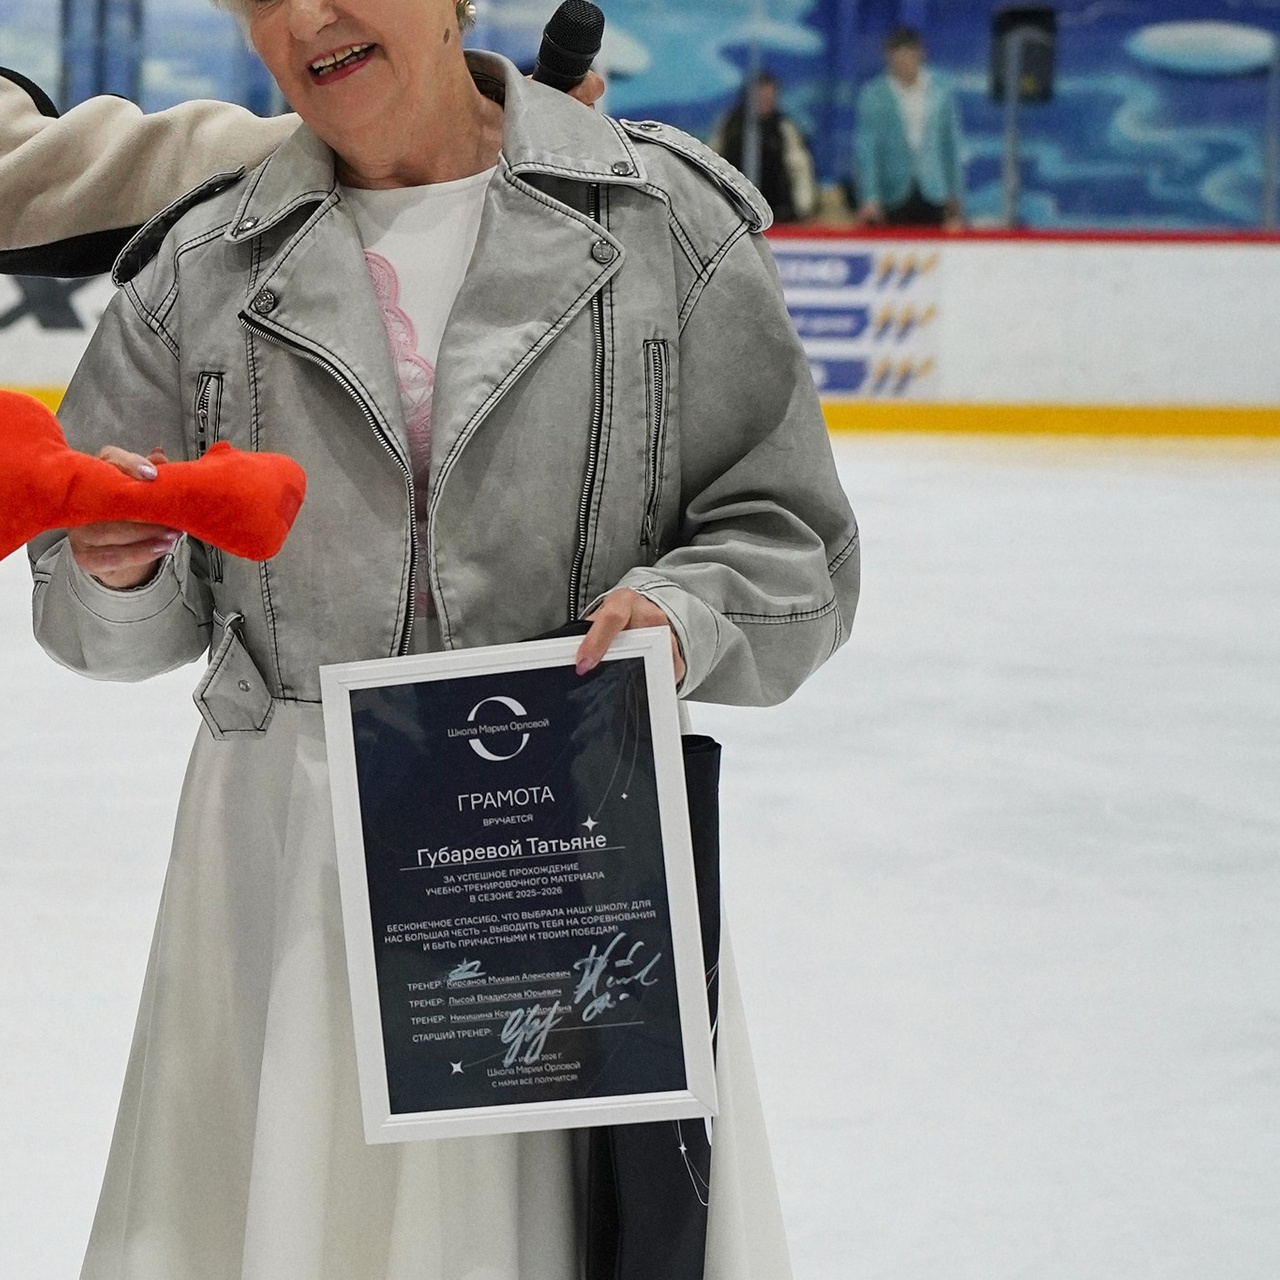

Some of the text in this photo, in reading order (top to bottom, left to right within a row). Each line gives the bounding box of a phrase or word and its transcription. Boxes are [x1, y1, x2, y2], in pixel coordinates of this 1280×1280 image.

[447, 718, 550, 738] Школа Марии Орловой
[457, 786, 555, 812] ГРАМОТА
[482, 813, 534, 827] ВРУЧАЕТСЯ
[417, 834, 607, 869] Губаревой Татьяне
[425, 871, 605, 896] УЧЕБНО-ТРЕНИРОВОЧНОГО МАТЕРИАЛА
[443, 862, 580, 884] ЗА УСПЕШНОЕ ПРОХОЖДЕНИЕ
[469, 894, 476, 903] В
[477, 891, 515, 903] СЕЗОНЕ
[384, 935, 403, 944] НАС
[404, 930, 450, 942] БОЛЬШАЯ
[451, 927, 480, 938] ЧЕСТЬ
[489, 922, 540, 934] ВЫВОДИТЬ
[541, 919, 564, 929] ТЕБЯ
[566, 917, 579, 927] НА
[580, 910, 656, 926] СОРЕВНОВАНИЯ
[386, 918, 453, 933] БЕСКОНЕЧНОЕ
[501, 912, 520, 922] ЧТО
[521, 907, 564, 920] ВЫБРАЛА
[566, 905, 593, 916] НАШУ
[631, 899, 651, 911] ДЛЯ
[423, 925, 619, 952] И БЫТЬ ПРИЧАСТНЫМИ К ТВОИМ ПОБЕДАМ!
[407, 980, 443, 992] ТРЕНЕР:
[488, 975, 521, 985] Михаил
[521, 970, 571, 982] Алексеевич
[409, 998, 445, 1009] ТРЕНЕР:
[477, 990, 523, 1003] Владислав
[523, 987, 562, 999] Юрьевич
[410, 1014, 447, 1026] ТРЕНЕР:
[412, 1027, 493, 1043] СТАРШИЙ ТРЕНЕР:
[486, 1061, 581, 1077] Школа Марии Орловой
[497, 1078, 519, 1087] НАМИ
